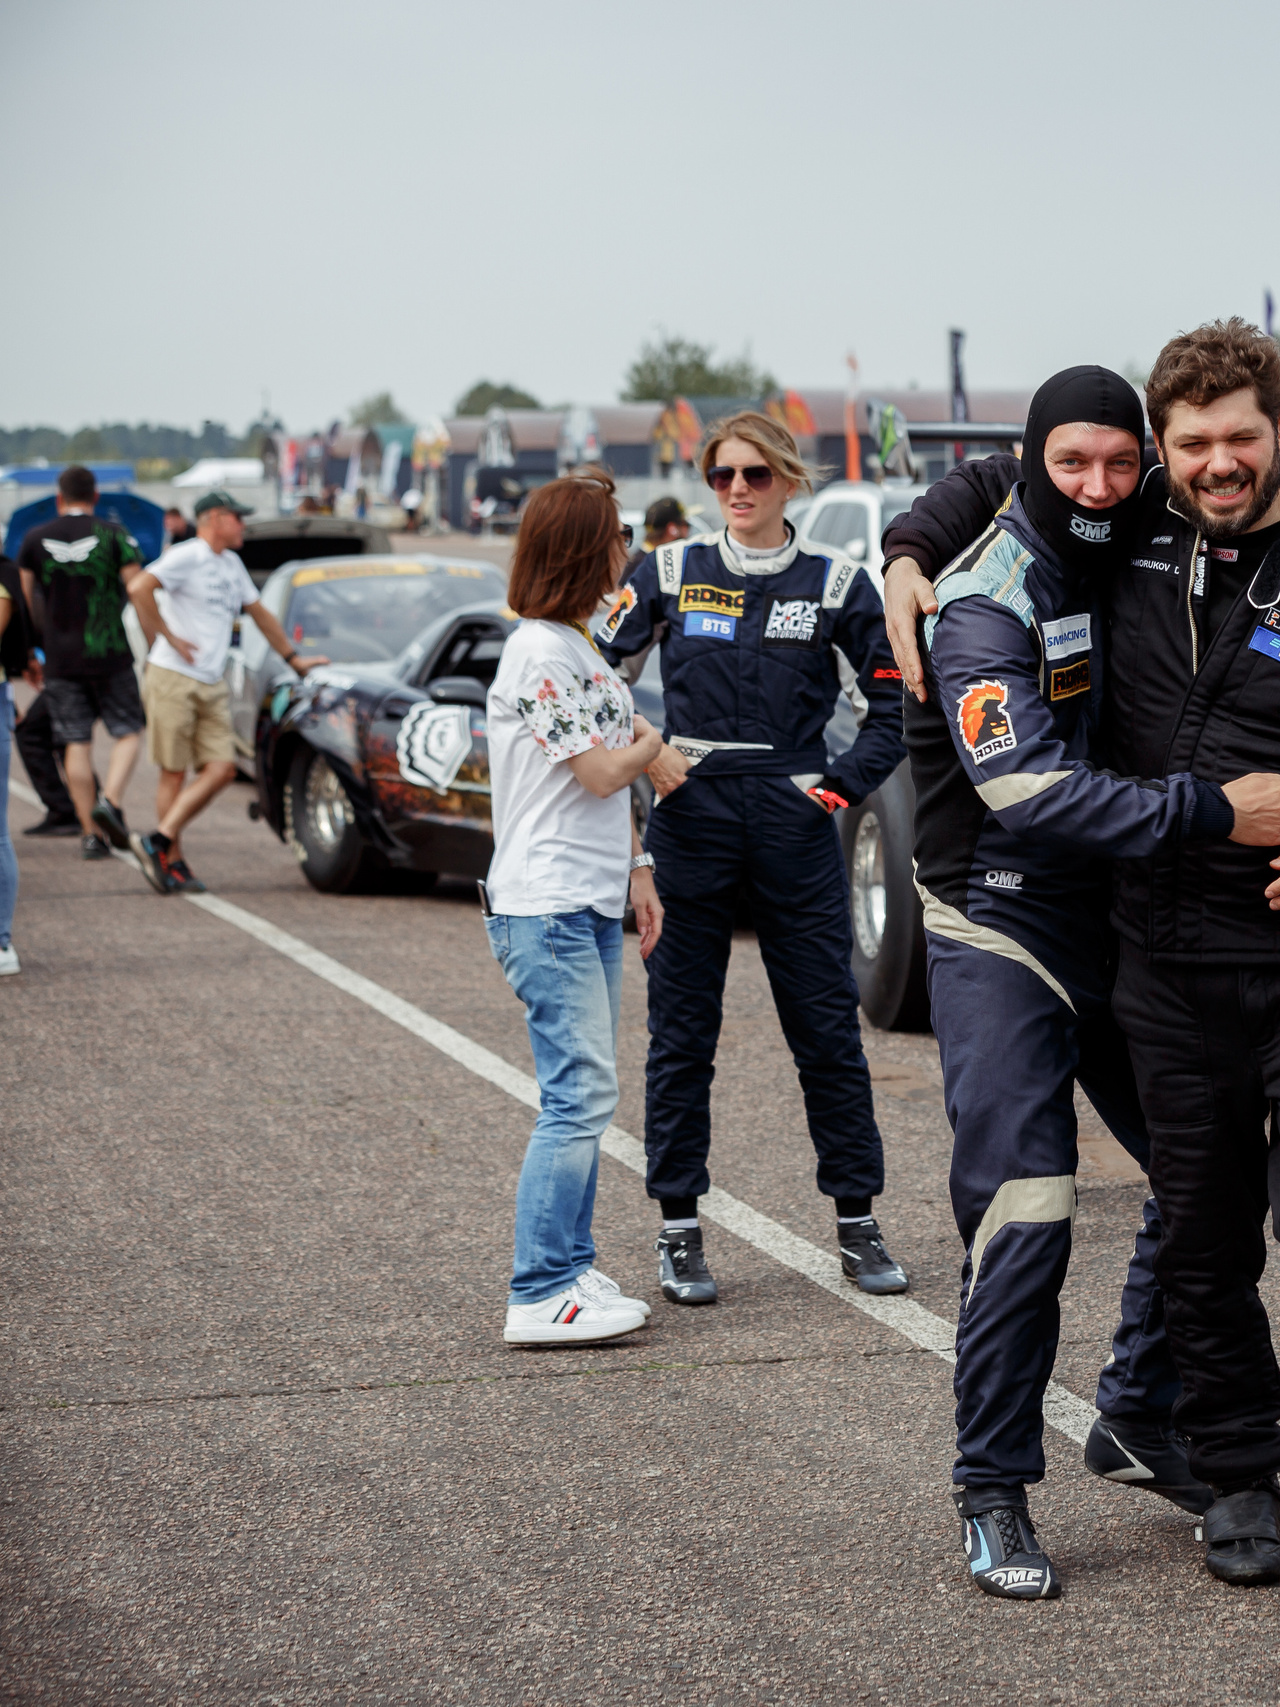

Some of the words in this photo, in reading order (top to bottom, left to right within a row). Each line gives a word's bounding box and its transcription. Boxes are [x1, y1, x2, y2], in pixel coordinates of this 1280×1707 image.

[1070, 517, 1111, 539] OMP
[1131, 557, 1171, 572] AMORUKOV
[1193, 555, 1206, 597] SIMPSON
[773, 599, 821, 619] MAX
[764, 629, 814, 642] MOTORSPORT
[985, 870, 1023, 888] OMP
[990, 1569, 1043, 1587] OMP
